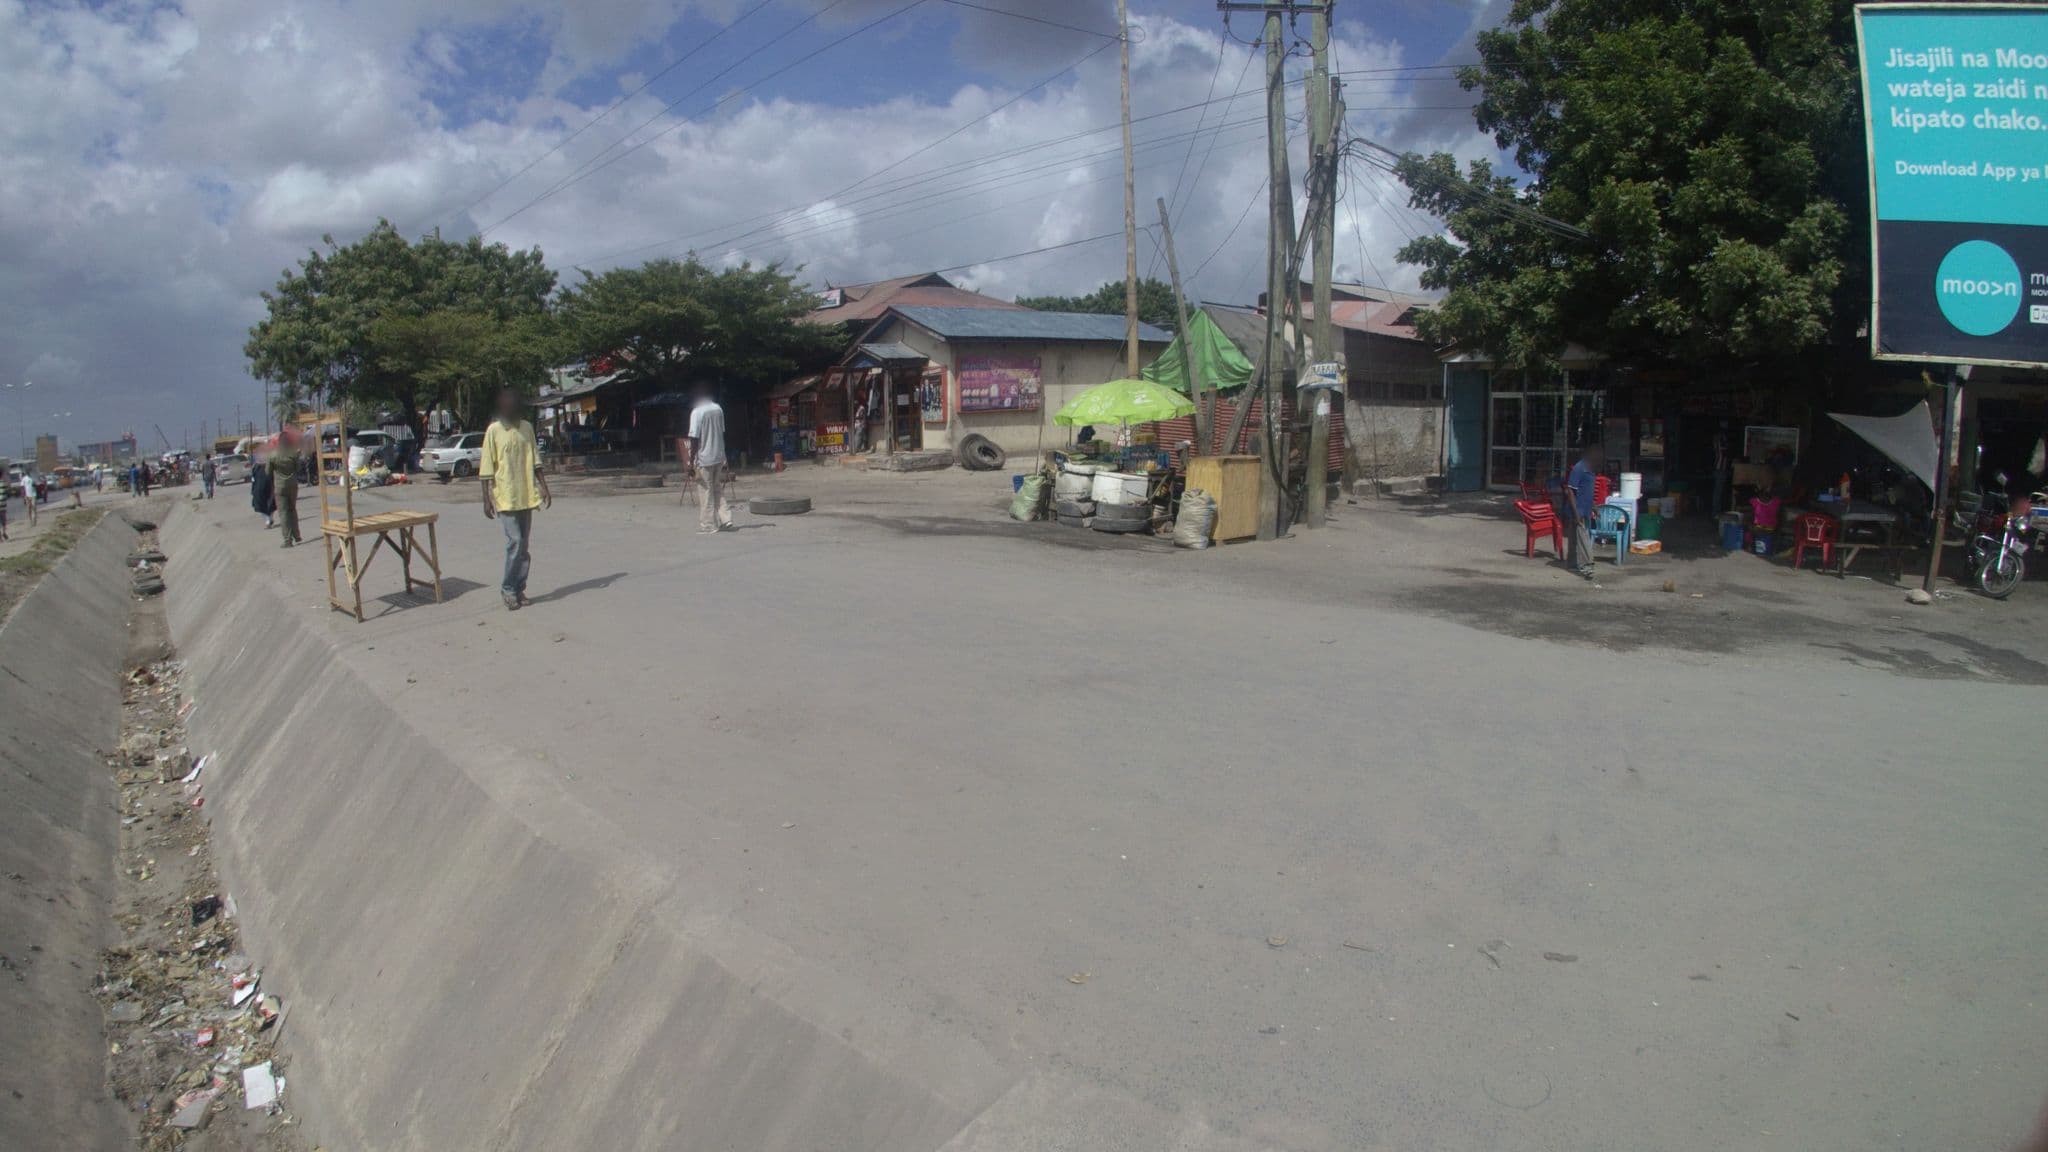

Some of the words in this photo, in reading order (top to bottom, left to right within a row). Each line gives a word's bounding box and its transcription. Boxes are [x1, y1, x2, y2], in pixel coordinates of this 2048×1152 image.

[1885, 47, 1954, 73] Jisajili
[1961, 53, 1989, 68] na
[1996, 48, 2048, 69] Moo
[1888, 78, 1966, 103] wateja
[1974, 78, 2027, 99] zaidi
[2034, 84, 2048, 100] n
[1891, 106, 1966, 134] kipato
[1973, 107, 2048, 130] chako.
[1895, 160, 1977, 177] Download
[1982, 162, 2016, 181] App
[2021, 167, 2040, 182] ya
[1943, 277, 2017, 297] moo>n
